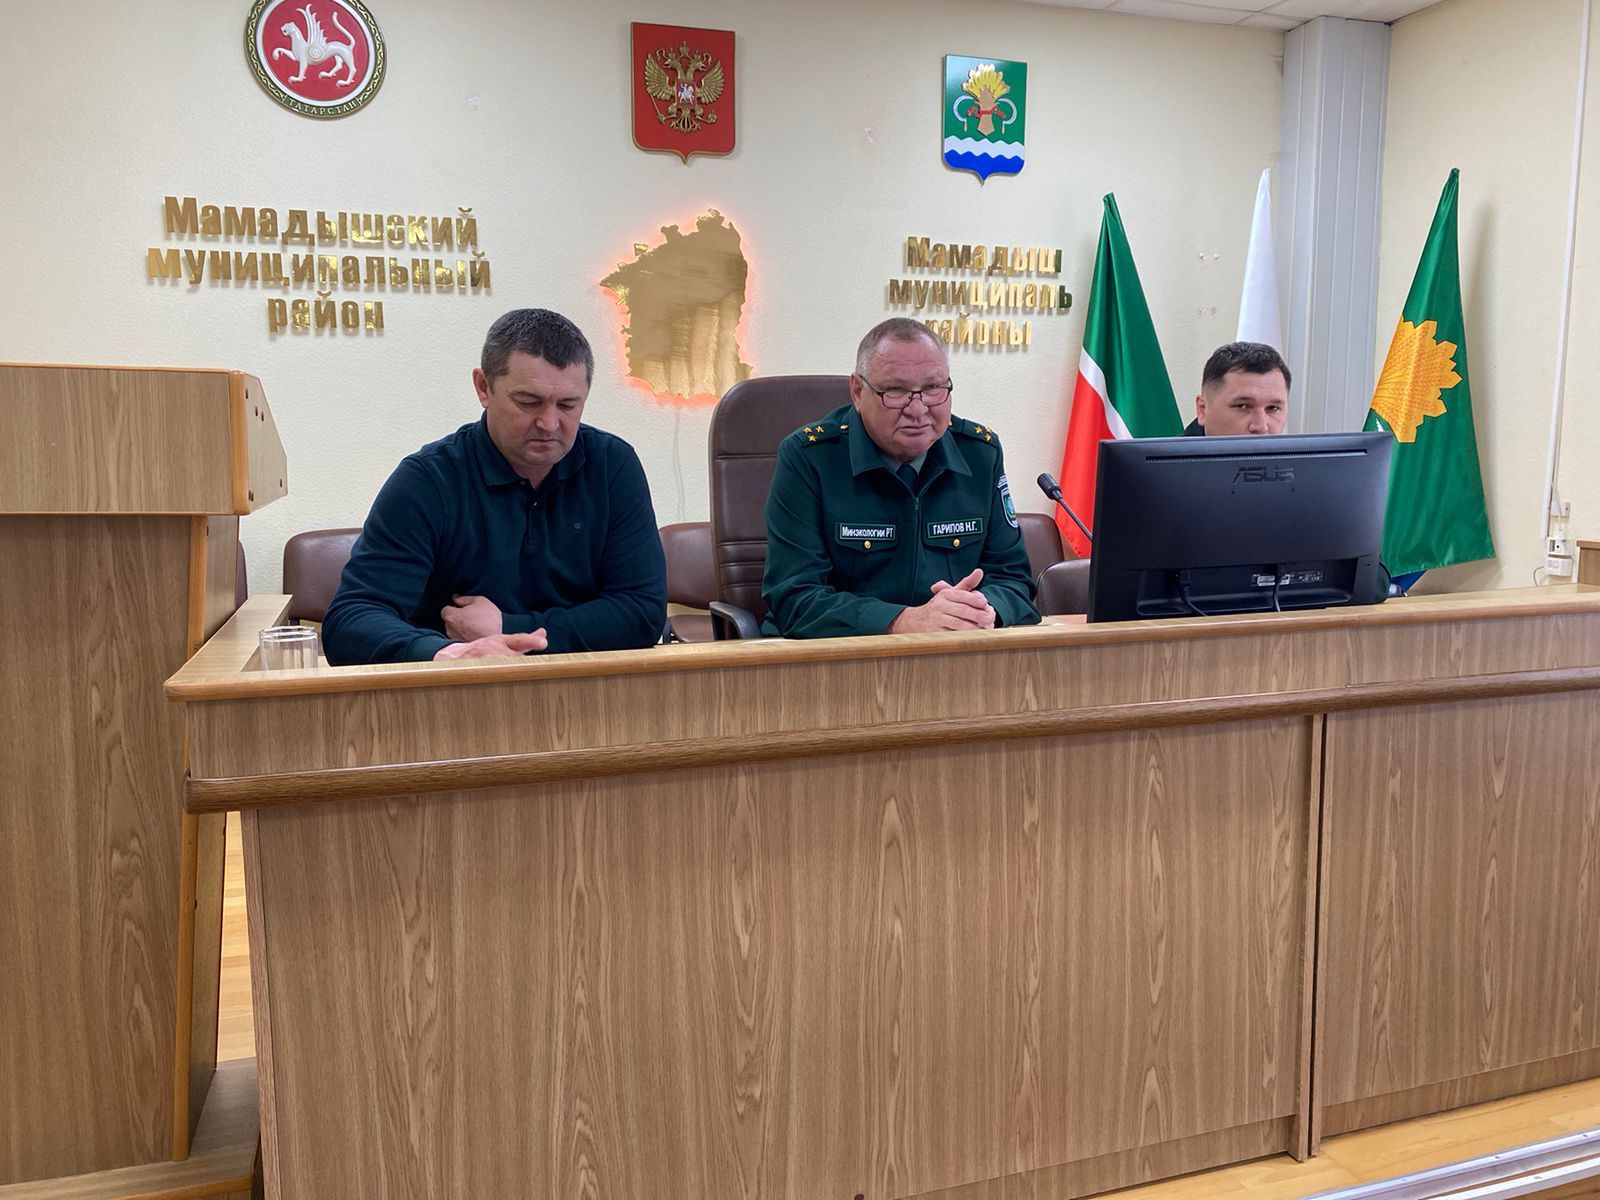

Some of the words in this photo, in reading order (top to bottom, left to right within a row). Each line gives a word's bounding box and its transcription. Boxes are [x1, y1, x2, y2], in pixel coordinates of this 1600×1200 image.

[289, 99, 357, 115] ТАТАРСТАН
[163, 195, 478, 247] Мамадышский
[147, 248, 492, 289] муниципальный
[907, 236, 1062, 276] Мамадыш
[888, 278, 1073, 311] муниципаль
[267, 290, 385, 333] район
[1232, 466, 1295, 484] ASUS
[885, 527, 894, 538] РТ
[933, 522, 965, 535] ГАРИПОВ
